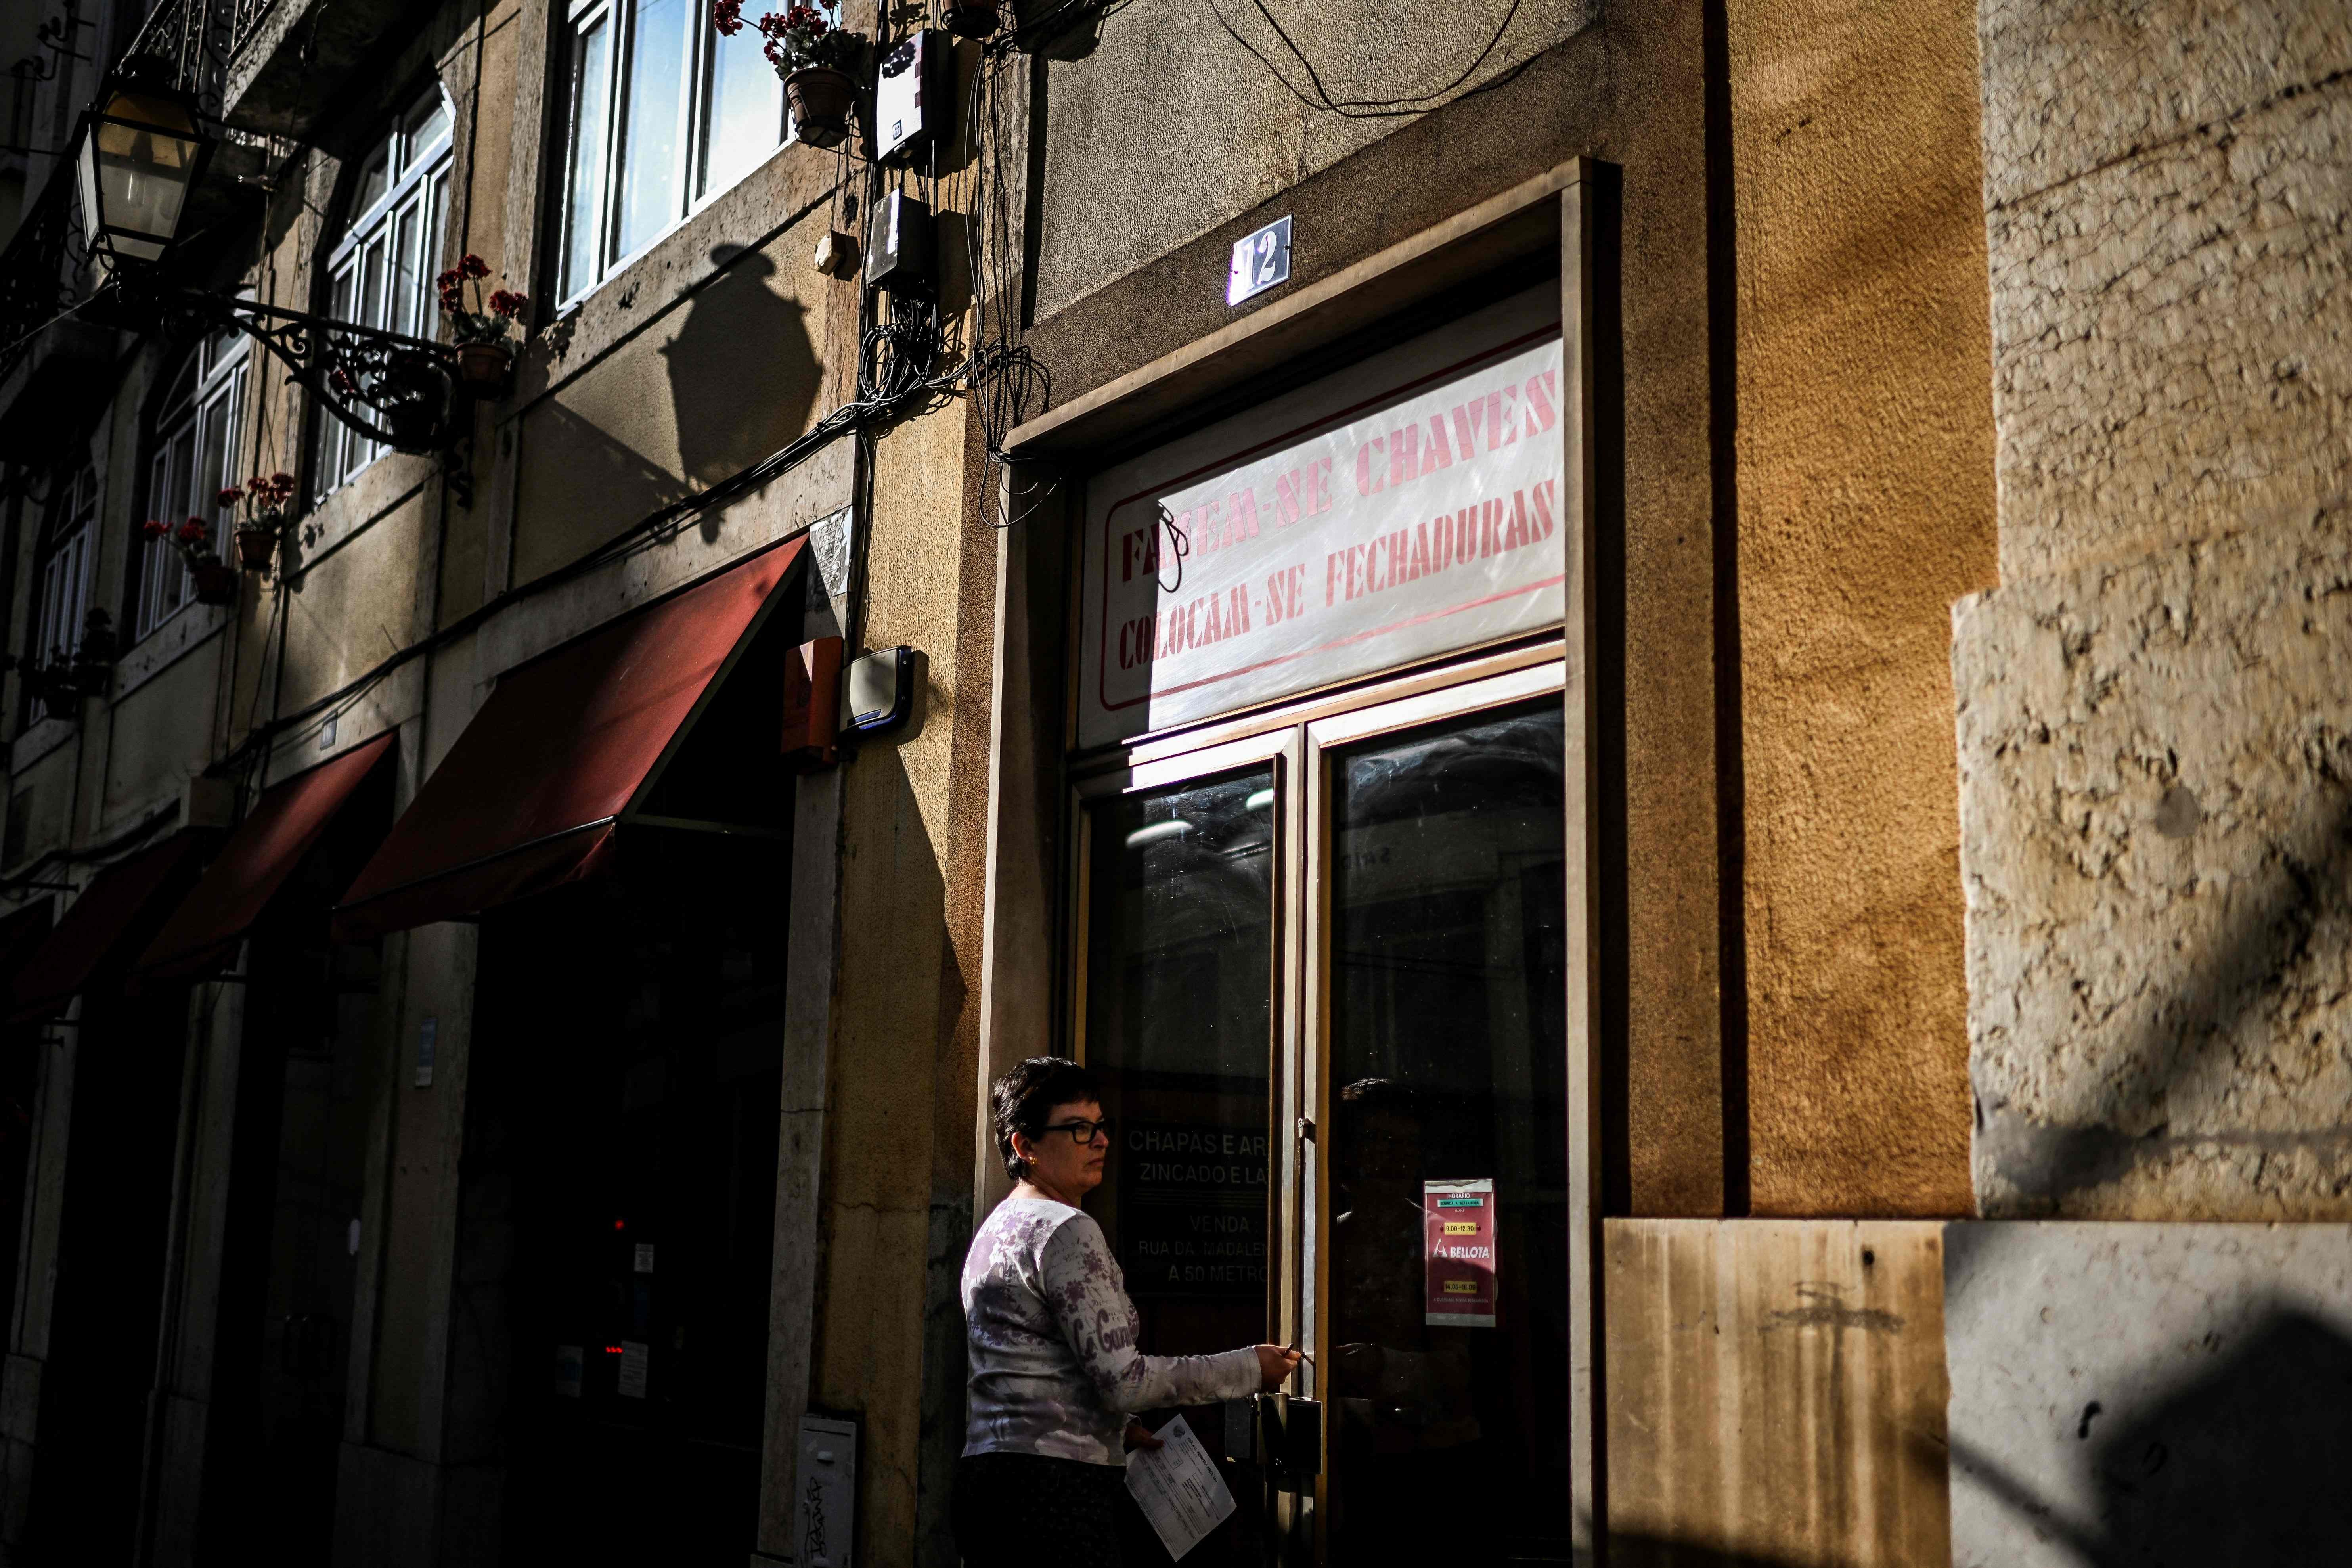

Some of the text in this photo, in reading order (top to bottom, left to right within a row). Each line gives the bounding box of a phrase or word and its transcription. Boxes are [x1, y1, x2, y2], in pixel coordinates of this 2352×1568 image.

[1242, 231, 1276, 293] 12
[1123, 369, 1556, 583] FAZEM-SE CHAVES
[1120, 479, 1554, 670] COLOCAM-SE FECHADURAS
[1129, 1130, 1217, 1154] CHAPAS
[1222, 1133, 1234, 1155] E
[1139, 1162, 1225, 1183] ZINCADO
[1230, 1166, 1241, 1185] E
[1139, 1240, 1170, 1256] RUA
[1175, 1241, 1195, 1256] DA
[1450, 1247, 1489, 1258] BELLOTA
[1184, 1266, 1205, 1282] 50
